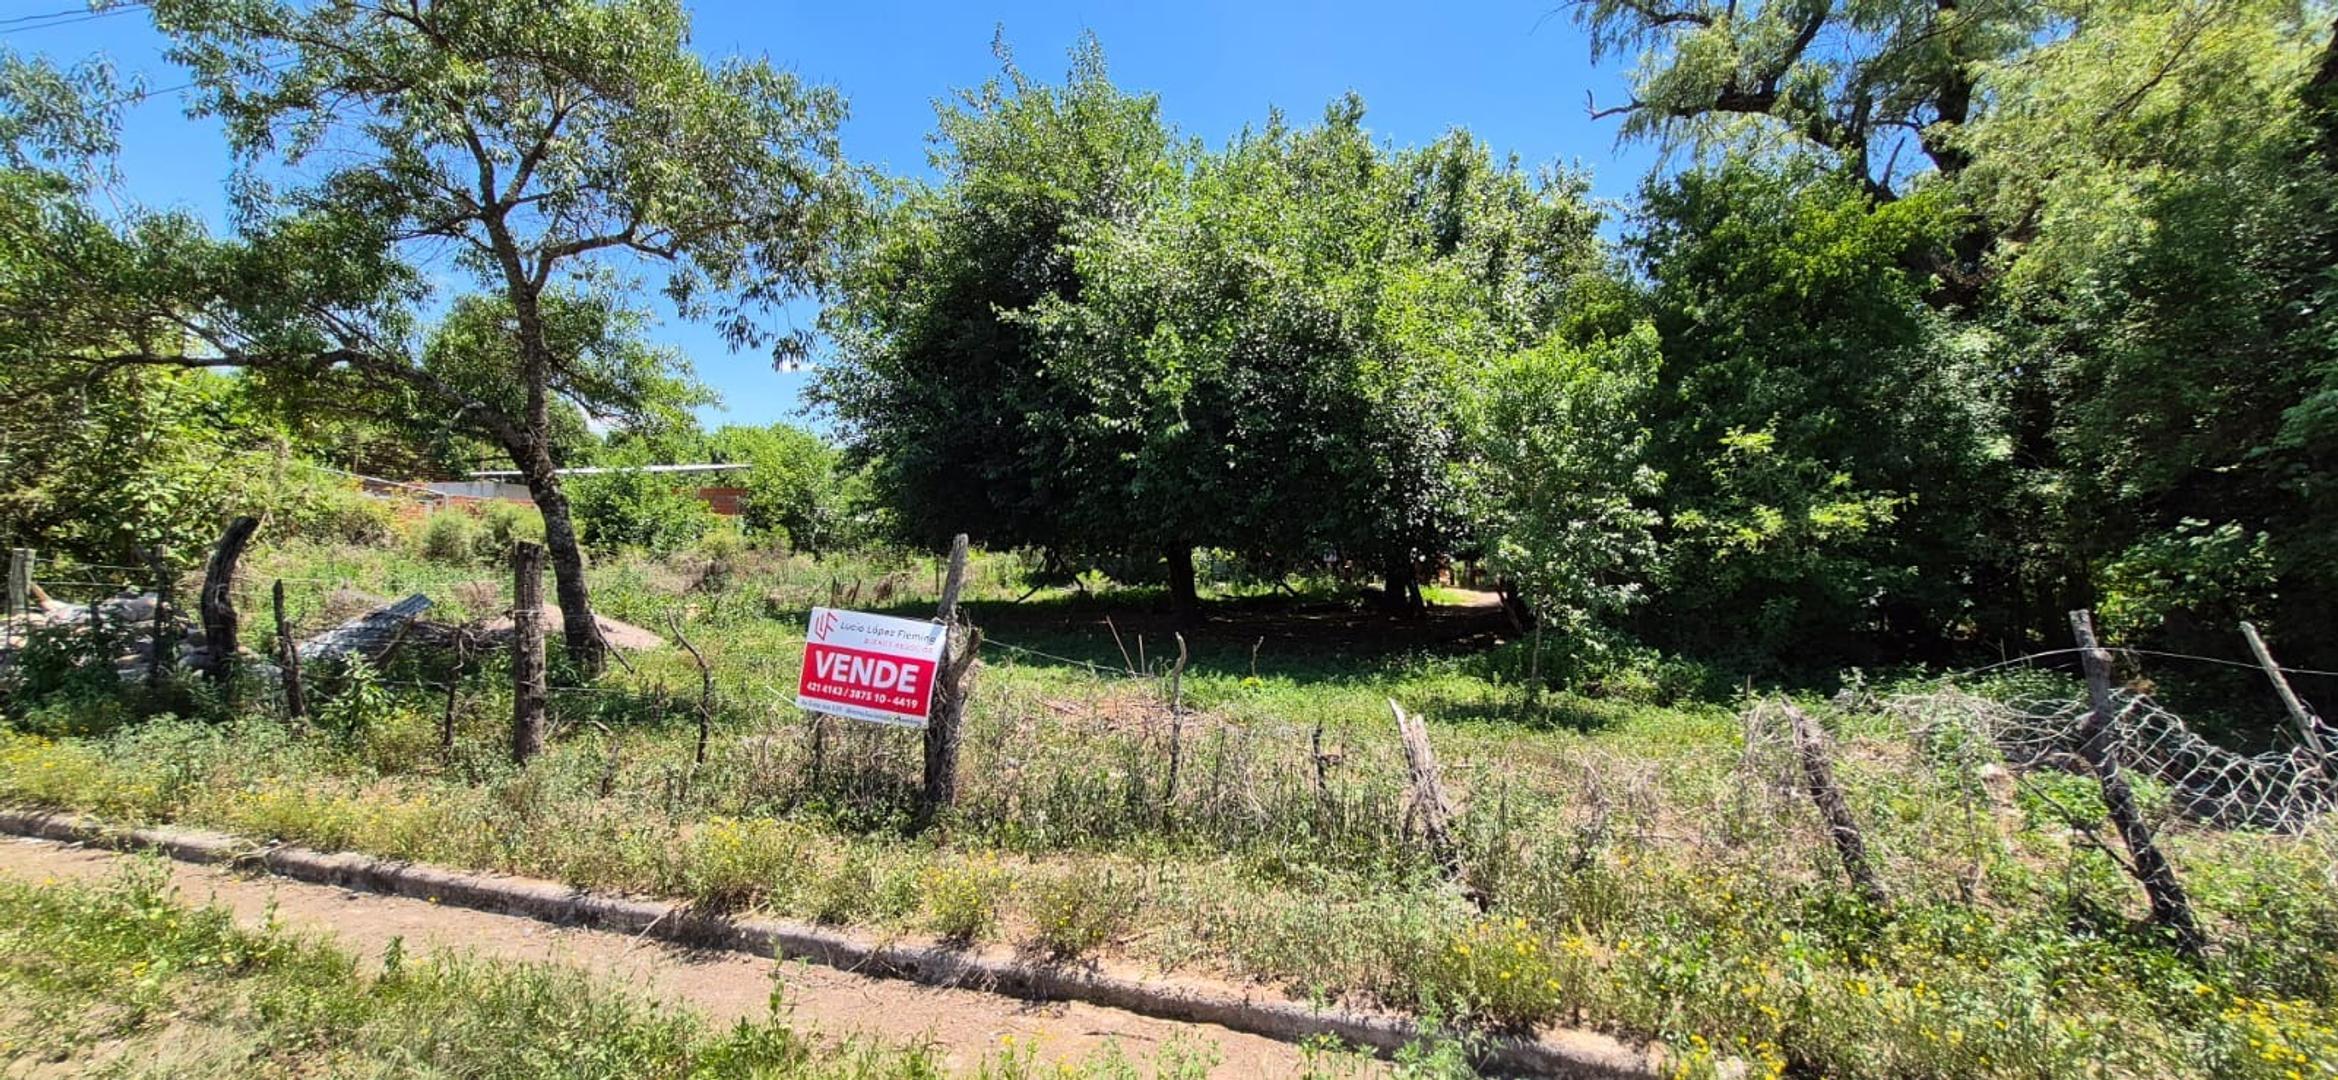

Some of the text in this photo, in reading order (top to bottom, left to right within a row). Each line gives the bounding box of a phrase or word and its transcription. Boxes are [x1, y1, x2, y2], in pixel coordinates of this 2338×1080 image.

[897, 629, 937, 645] Fleming
[815, 650, 920, 694] VENDE
[807, 682, 821, 692] 421
[875, 693, 887, 704] 10
[892, 697, 918, 708] 4419
